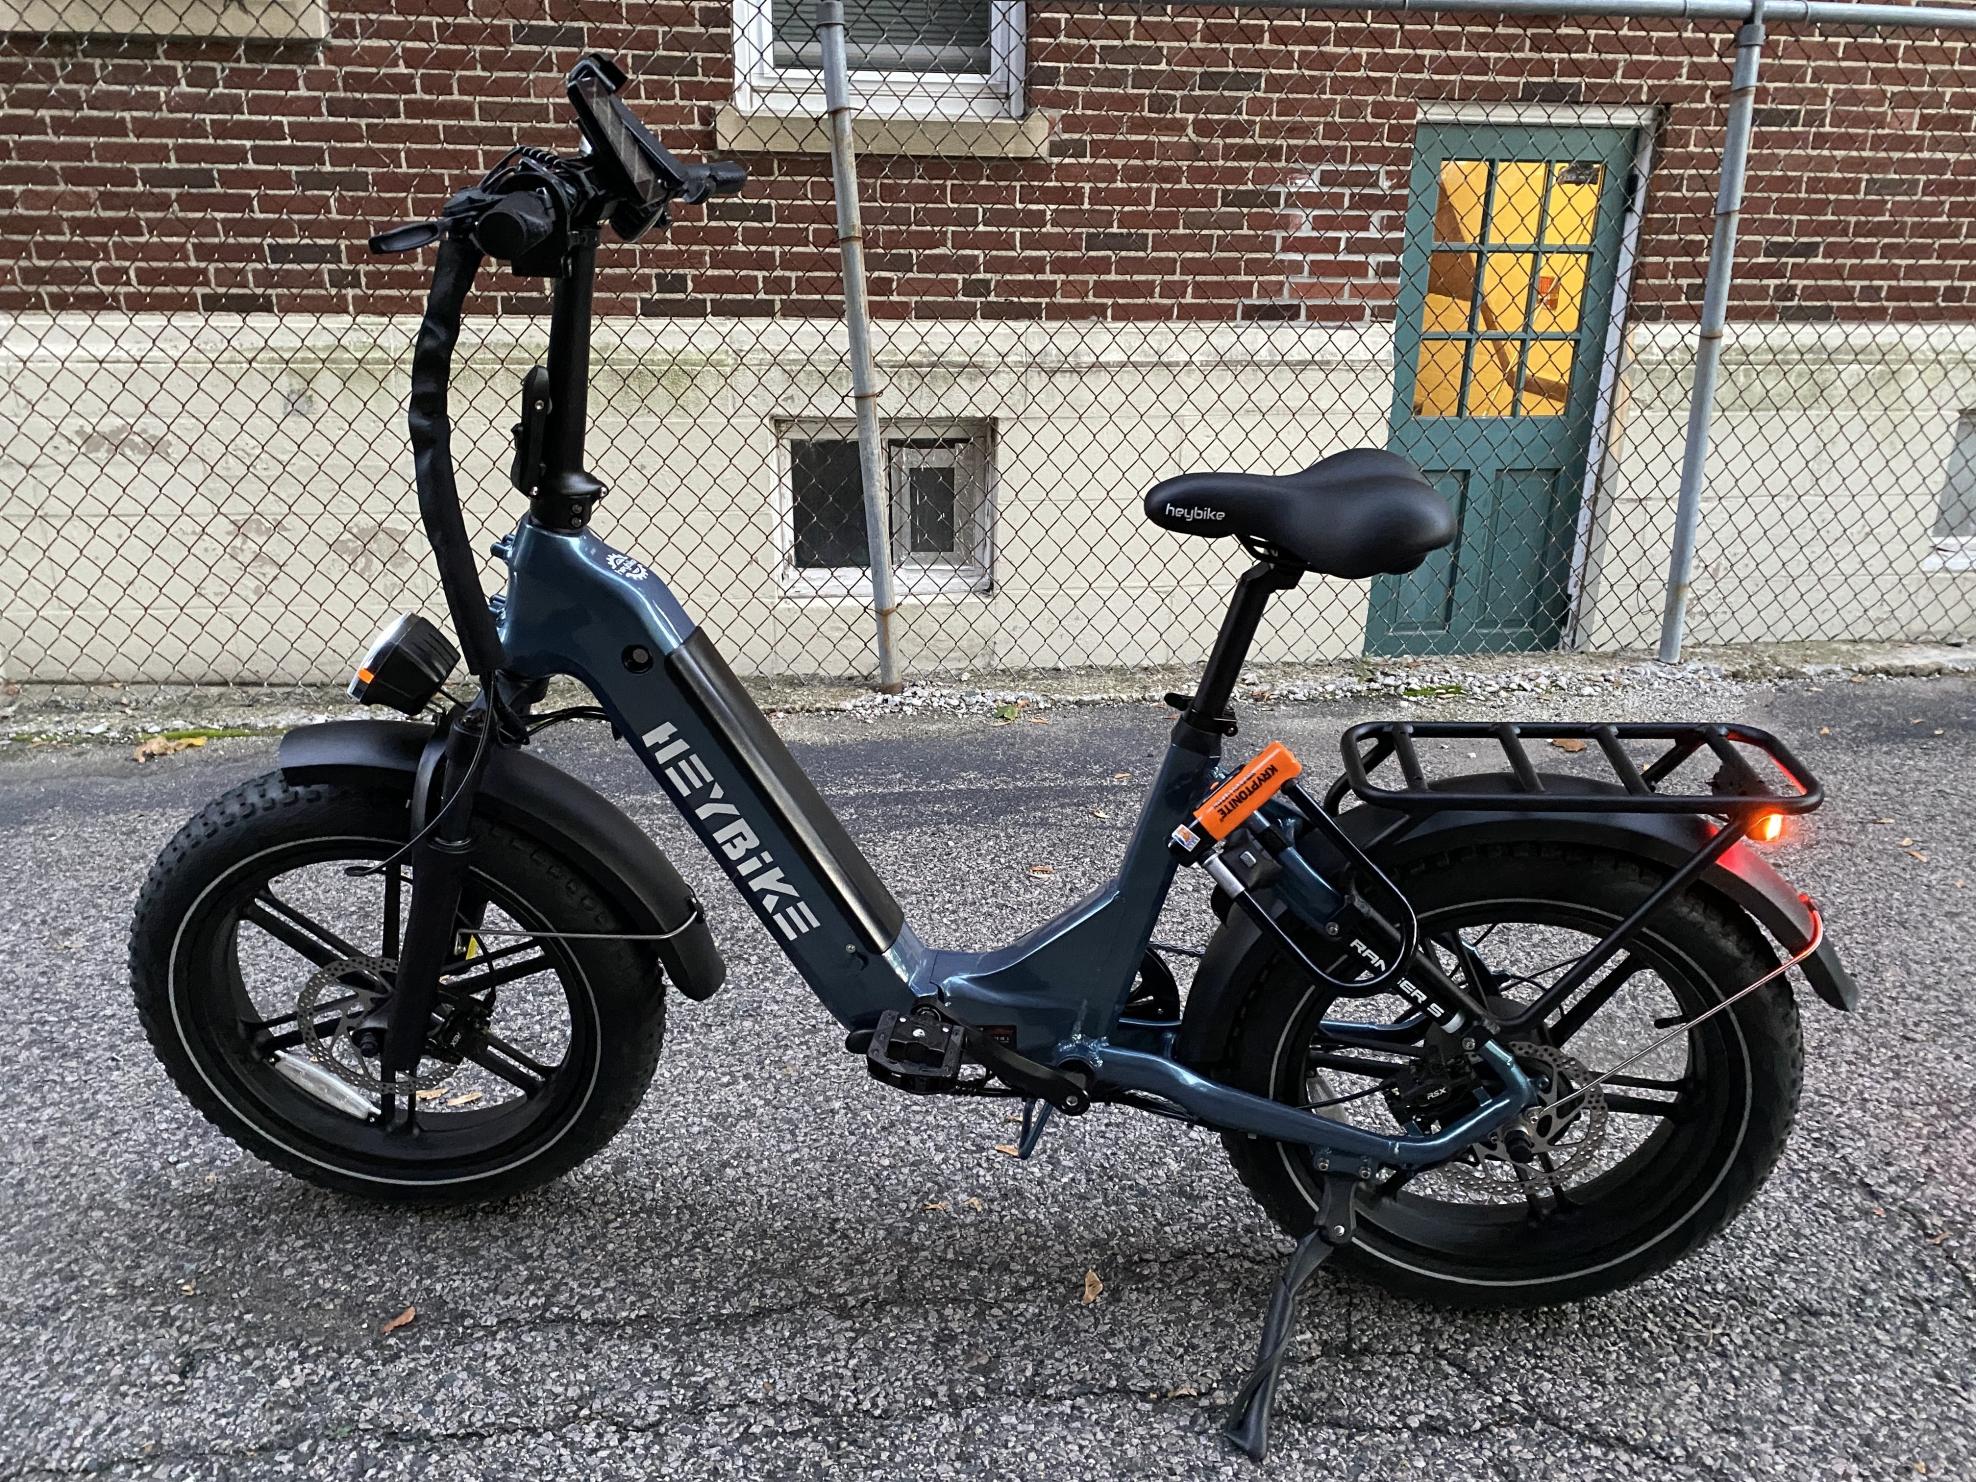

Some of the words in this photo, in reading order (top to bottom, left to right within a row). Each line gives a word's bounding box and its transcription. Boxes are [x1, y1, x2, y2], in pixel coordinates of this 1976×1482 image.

[1165, 503, 1226, 521] heybike
[1219, 764, 1279, 819] KRYPTONITE
[1350, 938, 1428, 1004] RANER
[1426, 1002, 1445, 1018] S
[1427, 1087, 1447, 1100] RSX
